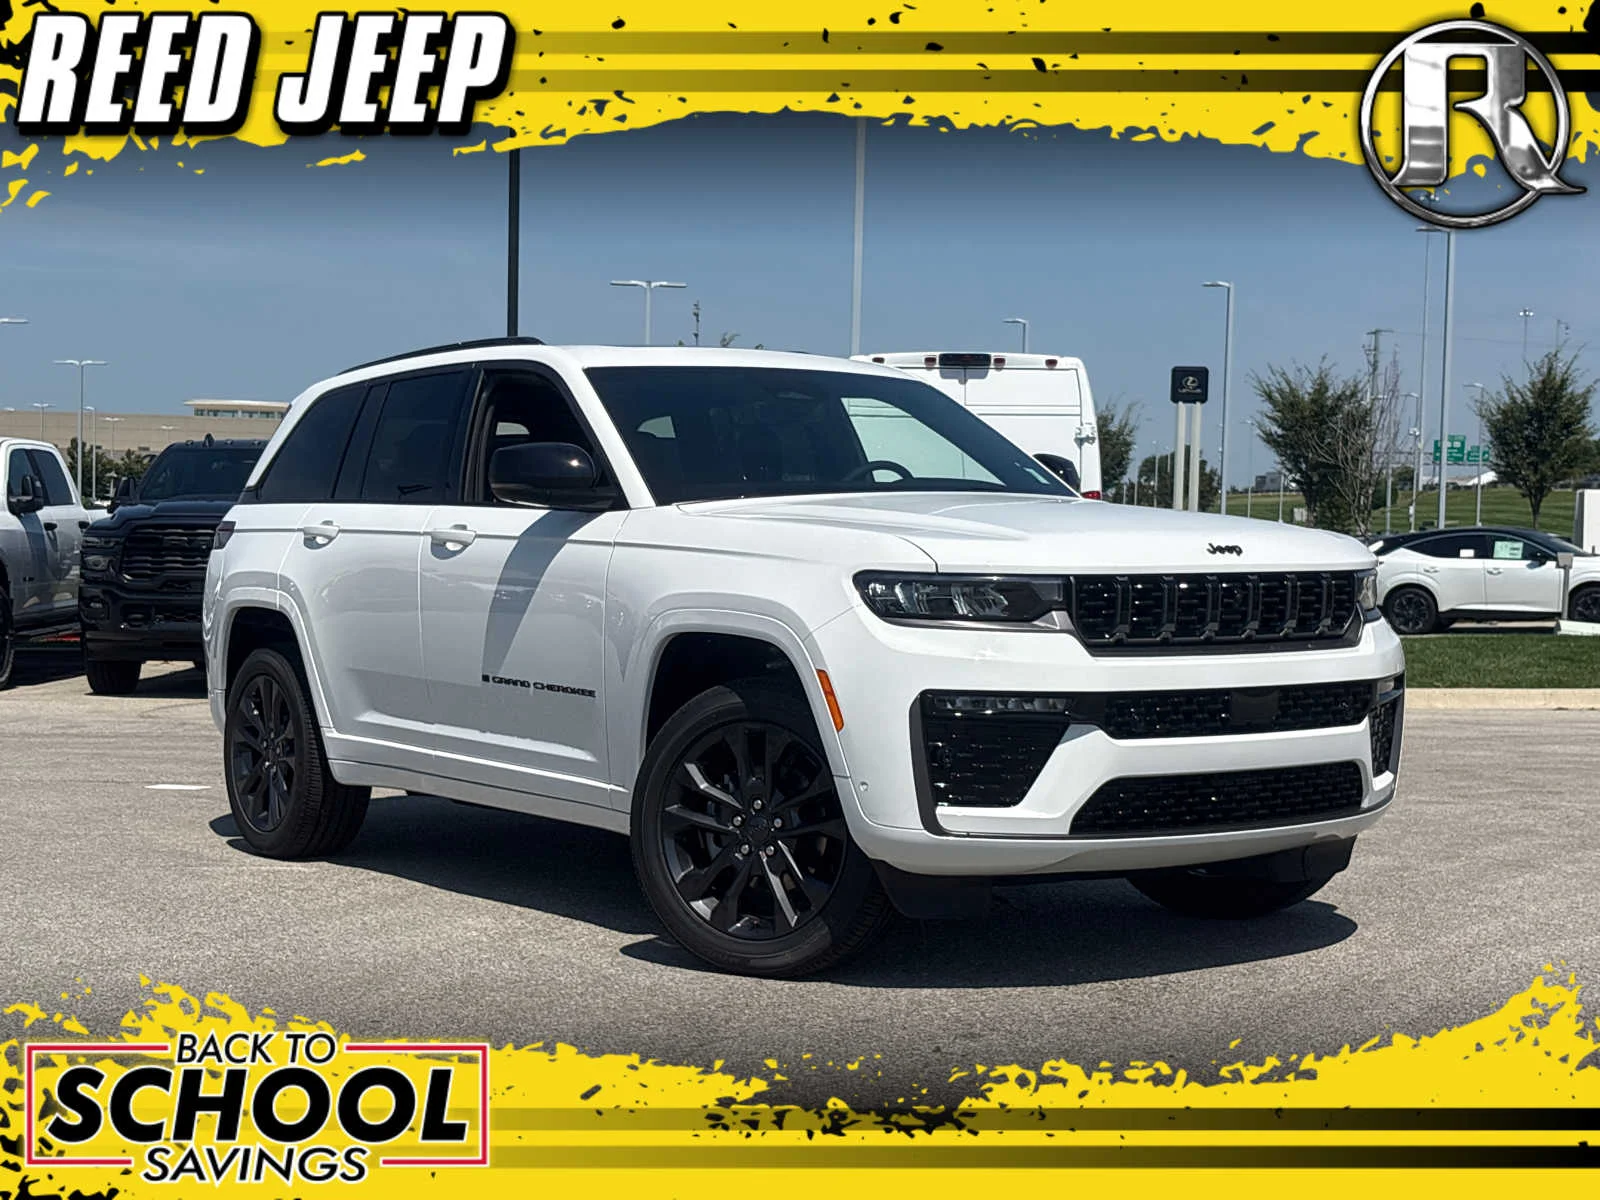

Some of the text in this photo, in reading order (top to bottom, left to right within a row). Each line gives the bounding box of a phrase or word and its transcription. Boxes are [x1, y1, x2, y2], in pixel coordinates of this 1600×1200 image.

[1206, 542, 1243, 557] Jeep
[491, 676, 597, 699] GRAND CHEROKEE
